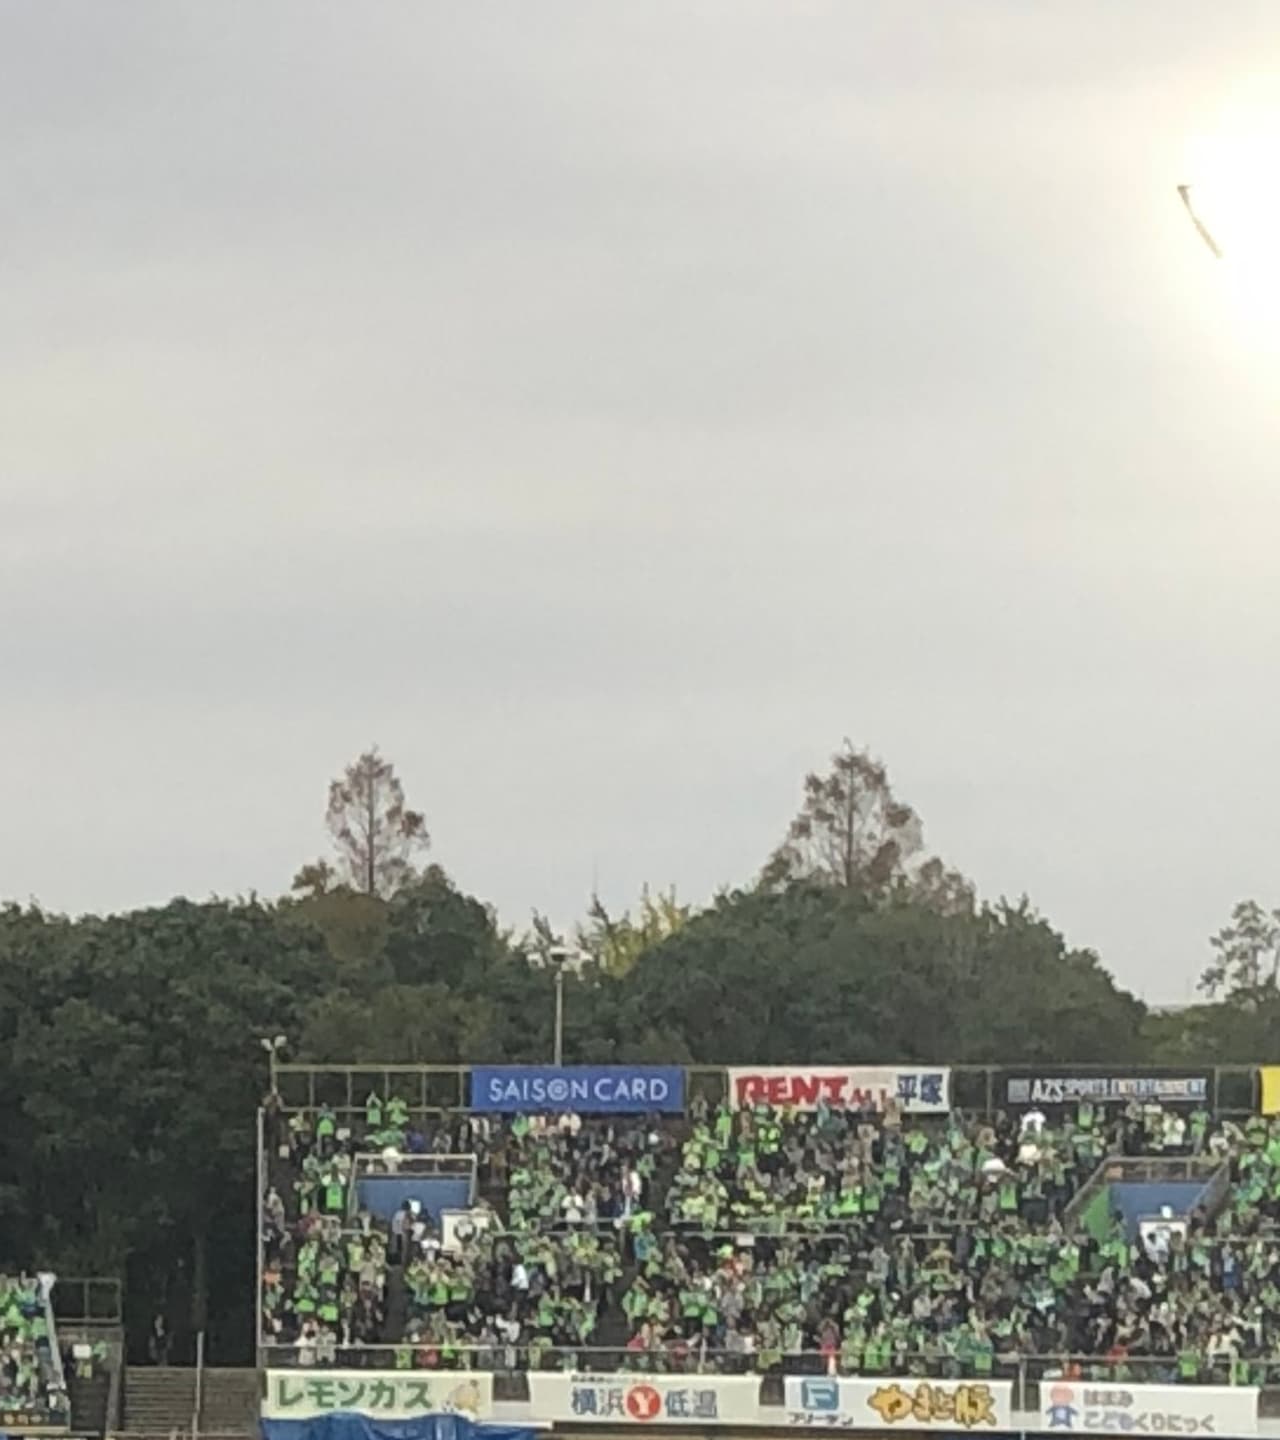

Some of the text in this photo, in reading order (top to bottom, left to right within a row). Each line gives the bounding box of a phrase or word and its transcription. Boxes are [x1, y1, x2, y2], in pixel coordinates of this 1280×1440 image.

[489, 1076, 668, 1101] SAISON CARD
[277, 1379, 433, 1409] レモンガス
